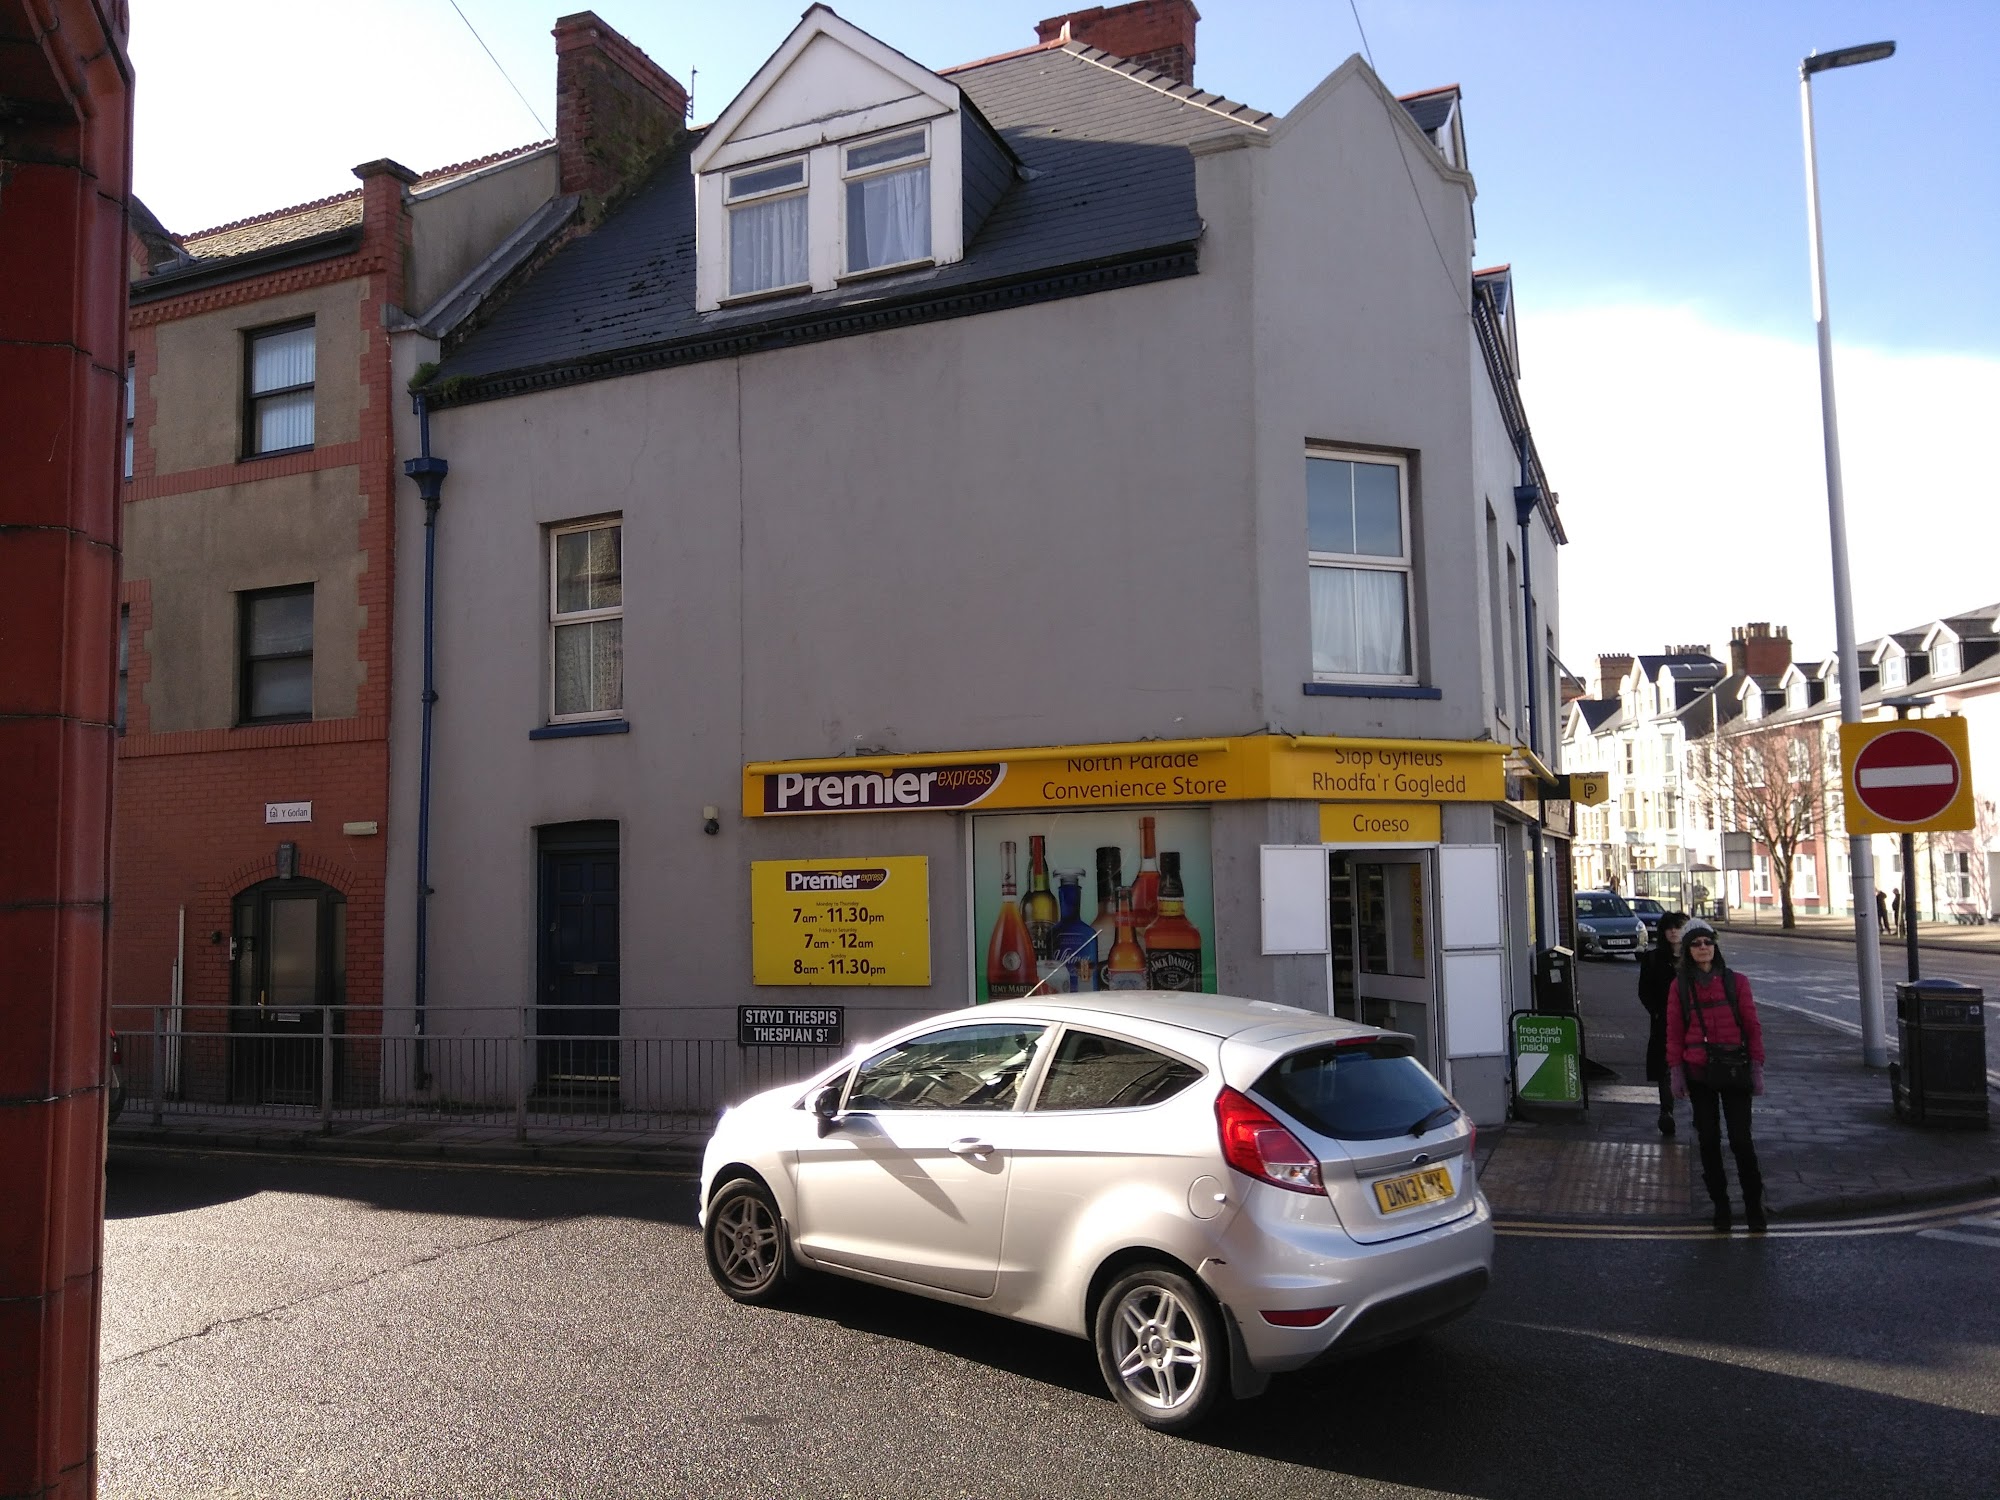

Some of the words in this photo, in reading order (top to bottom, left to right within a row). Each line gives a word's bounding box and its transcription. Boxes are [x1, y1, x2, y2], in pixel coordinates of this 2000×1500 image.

[1067, 756, 1122, 773] North
[1130, 753, 1199, 770] Parade
[1335, 748, 1373, 769] Siop
[778, 771, 938, 809] Premier
[938, 768, 992, 789] express
[1042, 780, 1167, 800] Convenience
[1173, 776, 1227, 795] Store
[1313, 772, 1390, 792] Rhodfa'r
[1395, 773, 1467, 798] Gogledd
[1353, 814, 1409, 833] Croeso
[791, 872, 861, 890] Premier
[860, 872, 884, 883] express
[793, 908, 817, 923] 7am
[827, 907, 884, 925] 11.30pm
[804, 934, 829, 949] 7am
[838, 933, 873, 949] 12am
[793, 959, 818, 974] 8am
[828, 959, 886, 976] 11.30pm
[1150, 957, 1168, 973] JACK
[745, 1009, 784, 1024] STRYD
[788, 1010, 837, 1025] THESPIS
[753, 1027, 812, 1042] THESPIAN
[1519, 1025, 1538, 1034] free
[1539, 1026, 1562, 1035] cash
[1520, 1034, 1561, 1044] machine
[1520, 1043, 1549, 1051] inside
